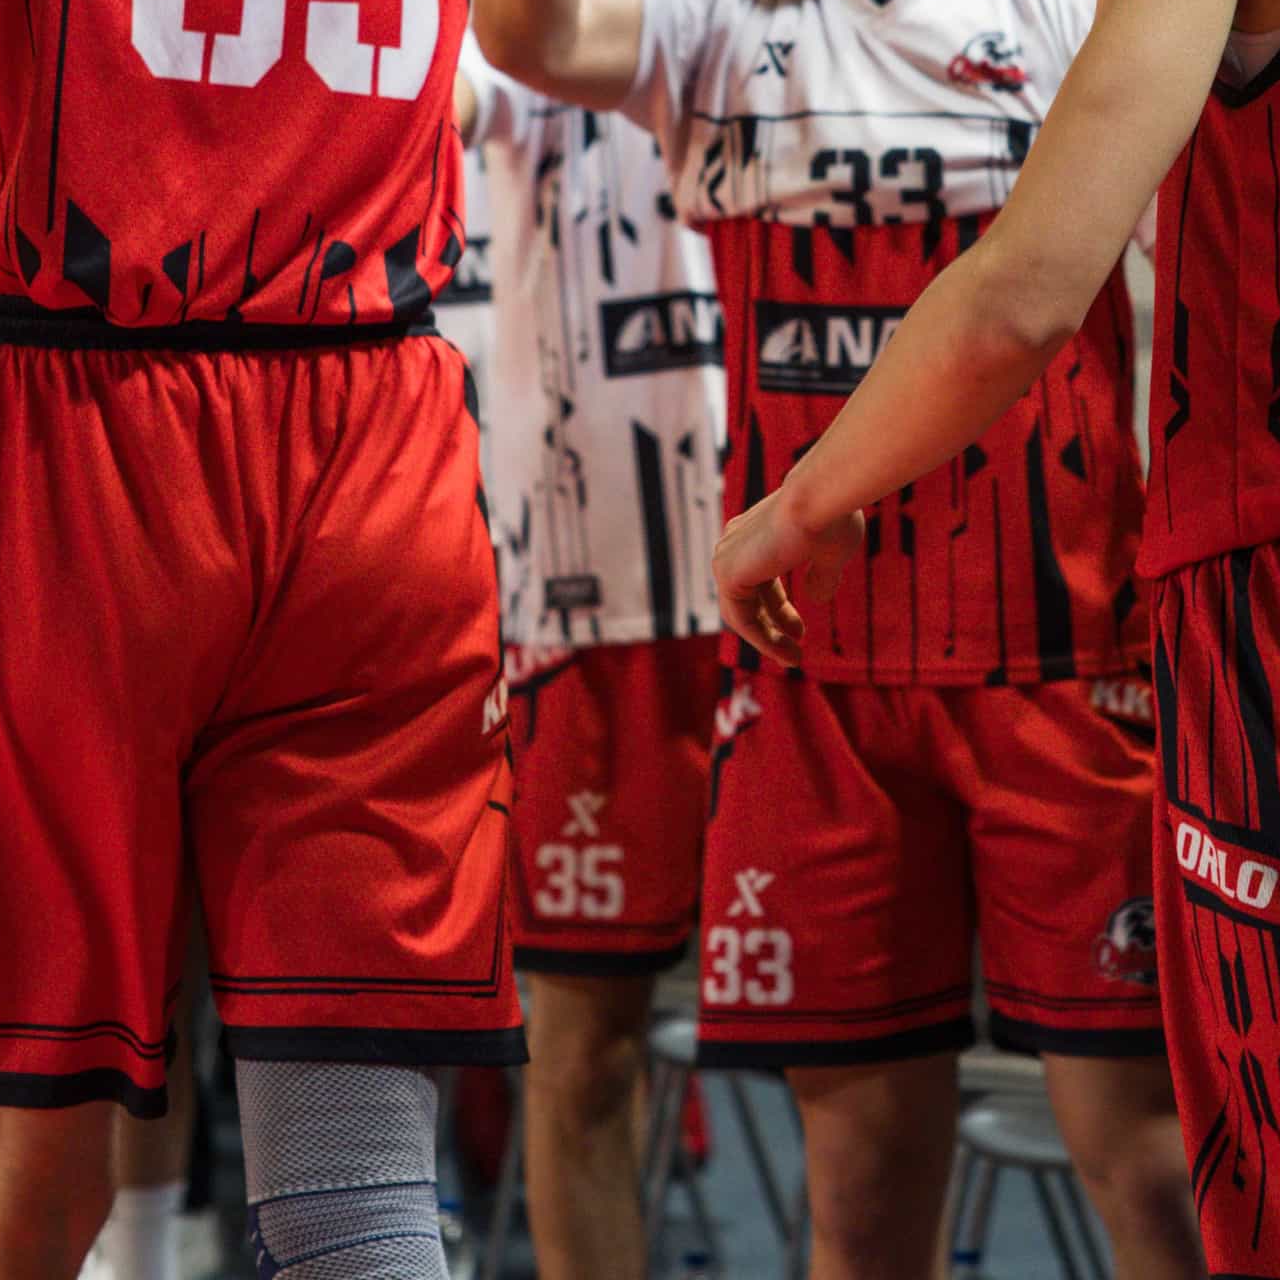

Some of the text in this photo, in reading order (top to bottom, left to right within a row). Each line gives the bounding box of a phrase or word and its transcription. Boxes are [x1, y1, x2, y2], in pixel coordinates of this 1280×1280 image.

[810, 148, 947, 227] 33
[535, 843, 624, 918] 35
[703, 925, 793, 1006] 33
